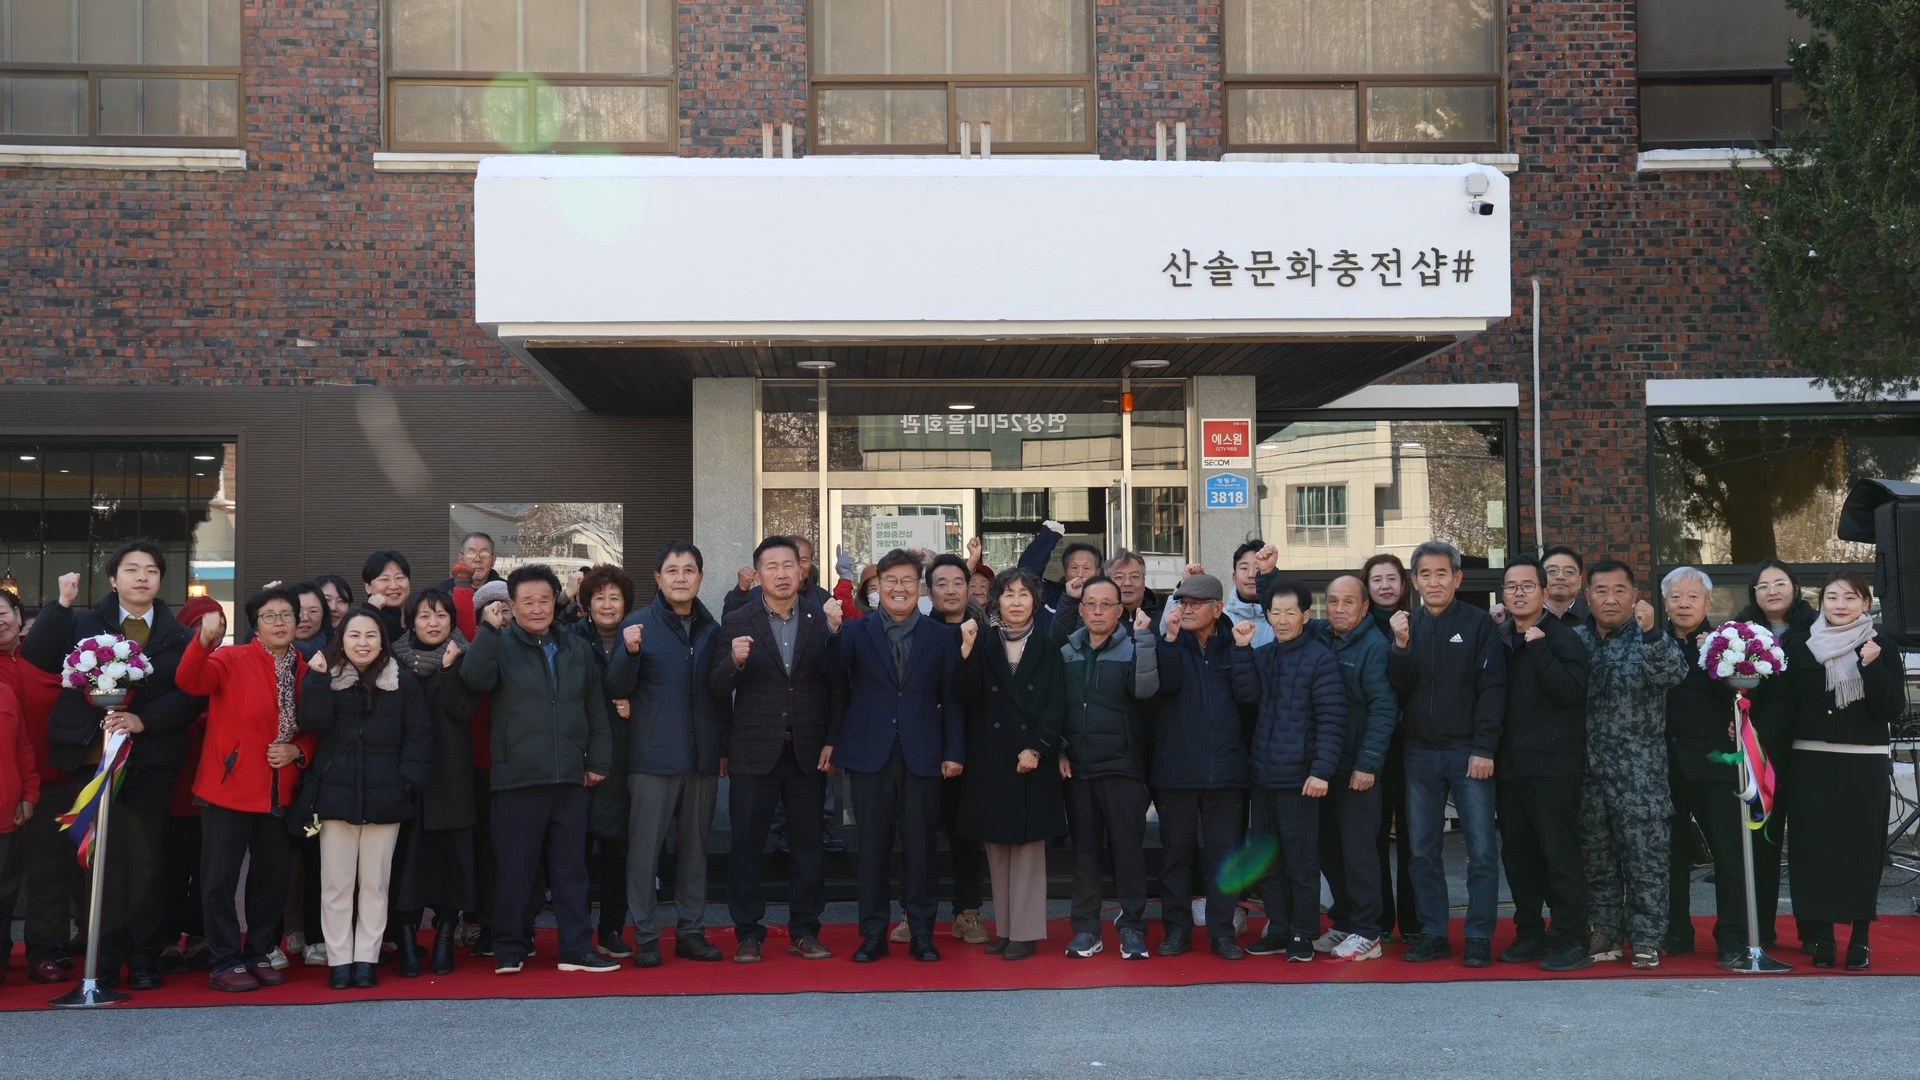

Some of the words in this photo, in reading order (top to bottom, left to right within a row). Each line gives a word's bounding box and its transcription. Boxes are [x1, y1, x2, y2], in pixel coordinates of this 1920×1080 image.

[1162, 247, 1475, 288] 산솔문화충전샵#
[1211, 433, 1242, 446] 에스원
[1210, 491, 1244, 504] 3818
[876, 521, 898, 529] 산솔면
[876, 540, 907, 548] 개장행사
